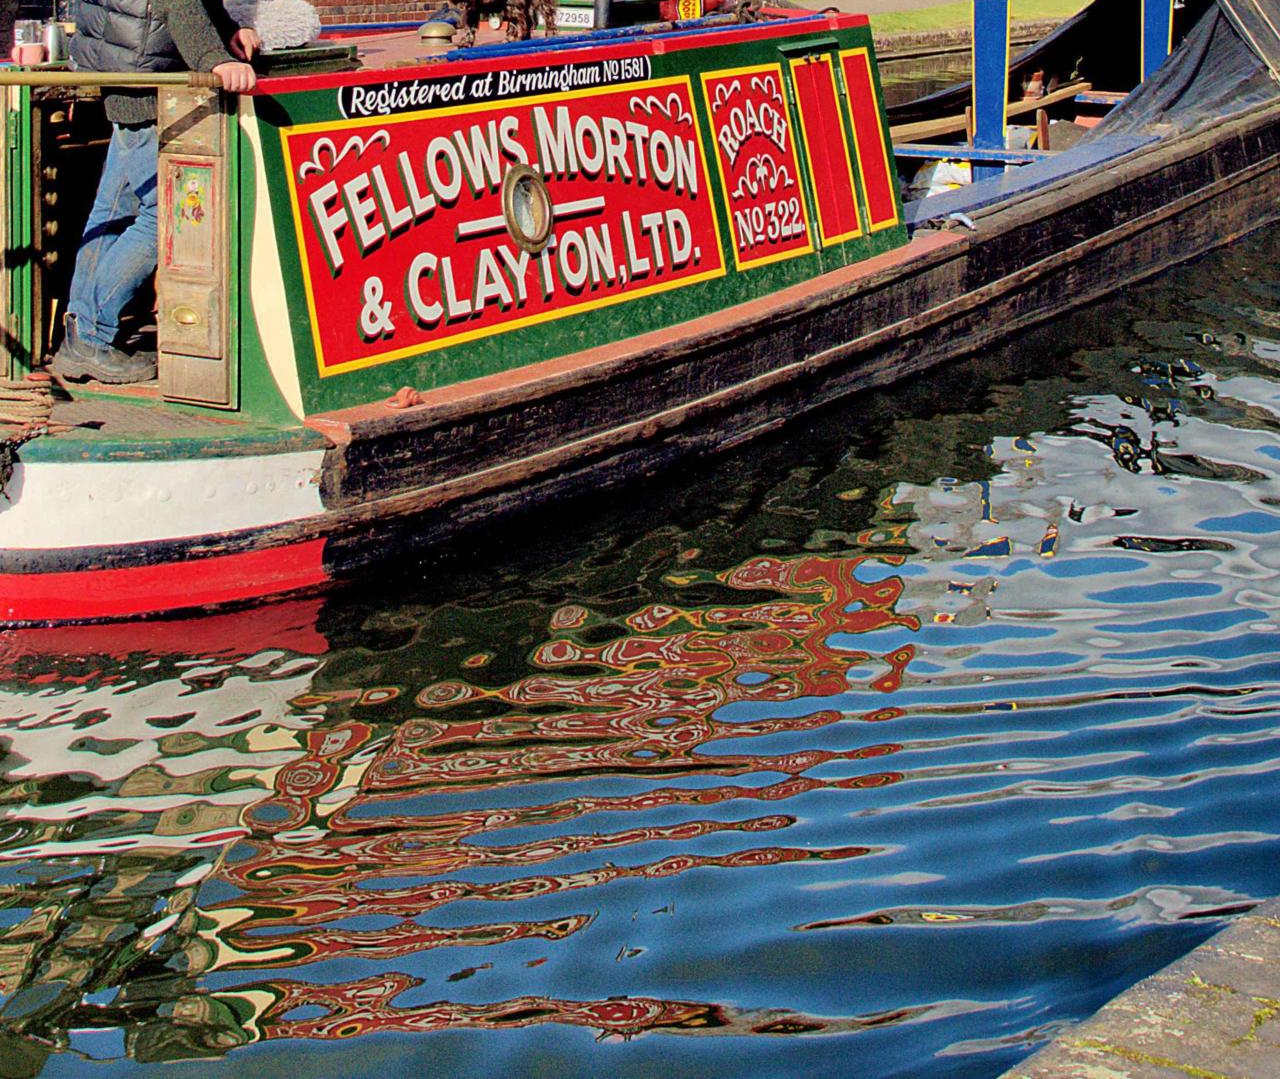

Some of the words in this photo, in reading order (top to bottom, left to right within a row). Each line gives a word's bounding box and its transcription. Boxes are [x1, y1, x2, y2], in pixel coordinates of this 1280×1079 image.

[337, 74, 467, 120] (Registered
[469, 72, 493, 98] at
[497, 63, 601, 96] Birmingham
[533, 106, 698, 194] MORTON
[718, 98, 788, 166] ROACH
[360, 275, 396, 335] &
[622, 208, 701, 275] LTD.
